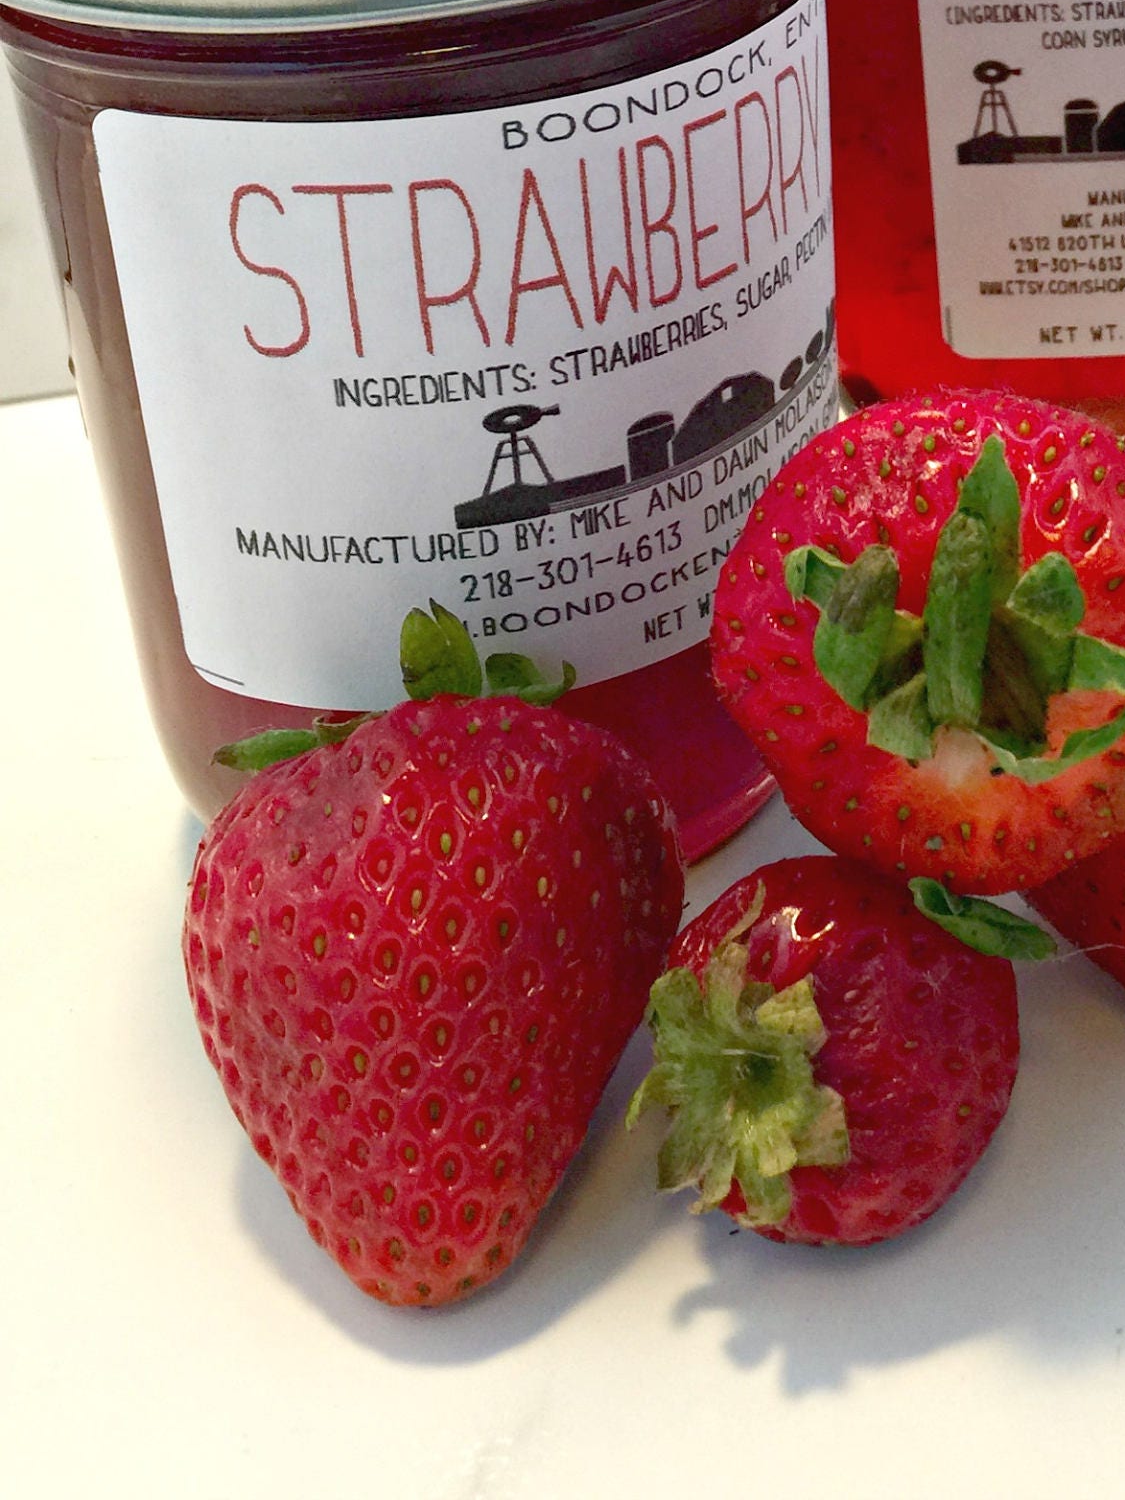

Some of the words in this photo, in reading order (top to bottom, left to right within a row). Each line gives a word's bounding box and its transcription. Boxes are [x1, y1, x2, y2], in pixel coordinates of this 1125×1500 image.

[1040, 28, 1087, 51] CORN
[500, 38, 773, 152] BOONDOCK,
[228, 33, 821, 359] STRAWBERRY
[332, 362, 538, 408] INGREDIENTS:
[548, 301, 729, 387] STRAWBERRIES,
[1038, 325, 1079, 344] NET
[1089, 323, 1124, 343] WT.
[235, 526, 499, 565] MANUFACTURED
[514, 517, 557, 552] BY:
[570, 496, 632, 540] MIKE
[646, 469, 704, 518] AND
[713, 428, 769, 487] DAWN
[459, 520, 683, 604] 218-301-4613
[643, 604, 687, 645] NET
